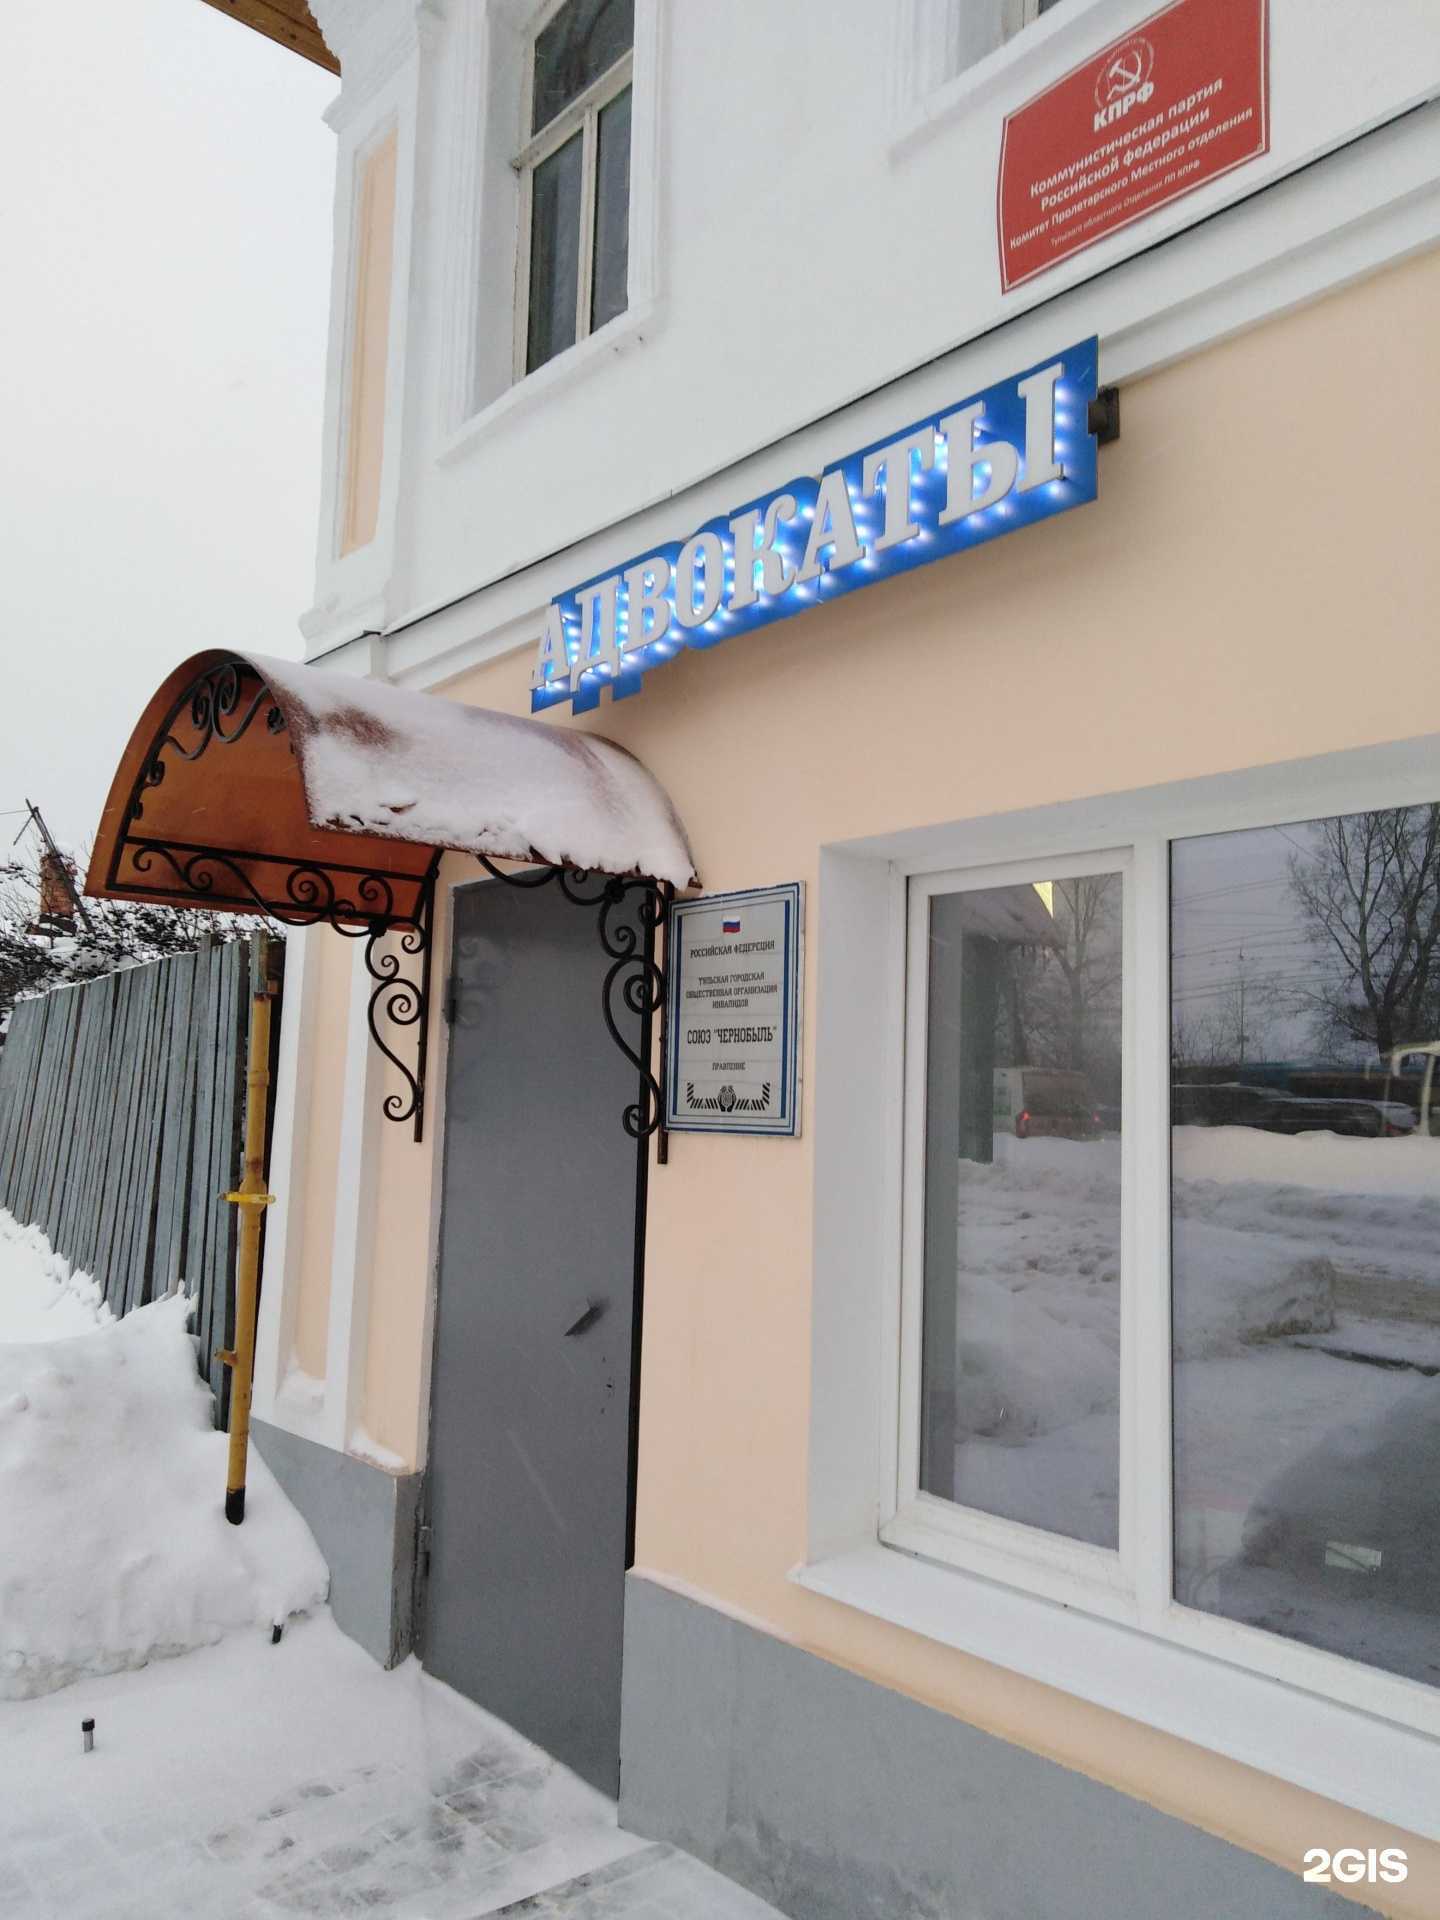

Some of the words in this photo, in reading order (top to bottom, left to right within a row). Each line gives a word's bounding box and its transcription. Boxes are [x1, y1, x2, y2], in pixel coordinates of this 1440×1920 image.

[1093, 81, 1154, 132] КПРФ
[1029, 111, 1164, 199] Коммунистическая
[1168, 77, 1223, 121] партия
[1040, 157, 1119, 212] Российской
[1123, 107, 1210, 168] федерации
[1009, 220, 1050, 250] Комитет
[1052, 176, 1129, 226] Пролетарского
[1130, 145, 1185, 182] Местного
[1187, 106, 1253, 152] отделения
[530, 362, 1065, 693] АДВОКАТЫ
[690, 943, 732, 959] РОССИЙСКАЯ
[730, 972, 765, 983] ГОРОДСКАЯ
[733, 984, 778, 996] ОРГАНИЗАЦИЯ
[712, 999, 749, 1009] ИНВАЛИДОВ
[687, 1029, 711, 1044] СОЮЗ
[713, 1026, 777, 1043] "ЧЕРНОБЫЛЬ"
